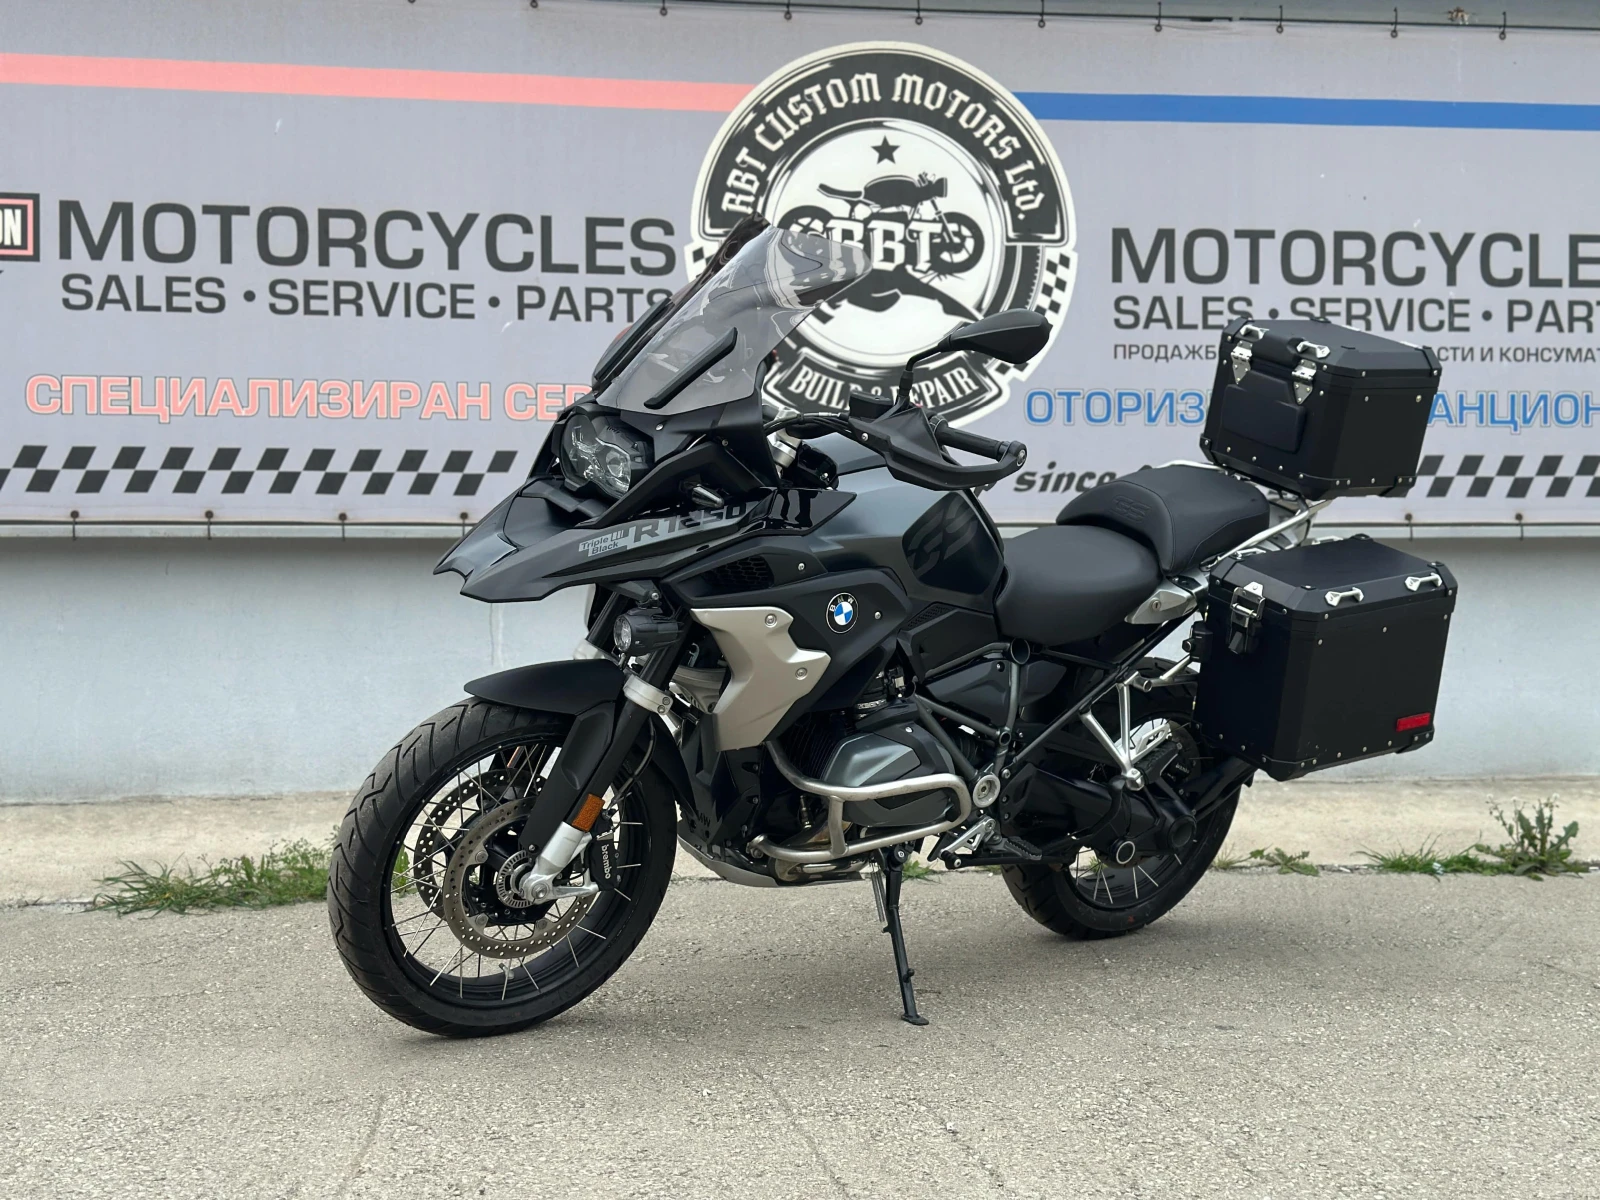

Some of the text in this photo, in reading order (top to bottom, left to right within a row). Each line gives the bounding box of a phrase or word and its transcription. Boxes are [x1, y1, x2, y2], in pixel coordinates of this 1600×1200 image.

[721, 146, 767, 215] RBT
[754, 72, 882, 151] CUSTOM
[891, 73, 1021, 160] MOTORS
[59, 200, 676, 276] MOTORCYCLES
[1111, 228, 1600, 289] MOTORCYCLE
[61, 273, 226, 314] SALES
[268, 279, 475, 319] SERVICE
[1290, 297, 1470, 333] SERVICE
[1507, 299, 1600, 334] PAR
[1113, 344, 1217, 363] ПРОДАЖБ
[25, 374, 492, 424] СПЕЦИАЛИЗИРАН
[581, 537, 609, 549] Triple
[591, 541, 619, 554] Black
[829, 595, 854, 612] BMW
[601, 844, 612, 880] brembo
